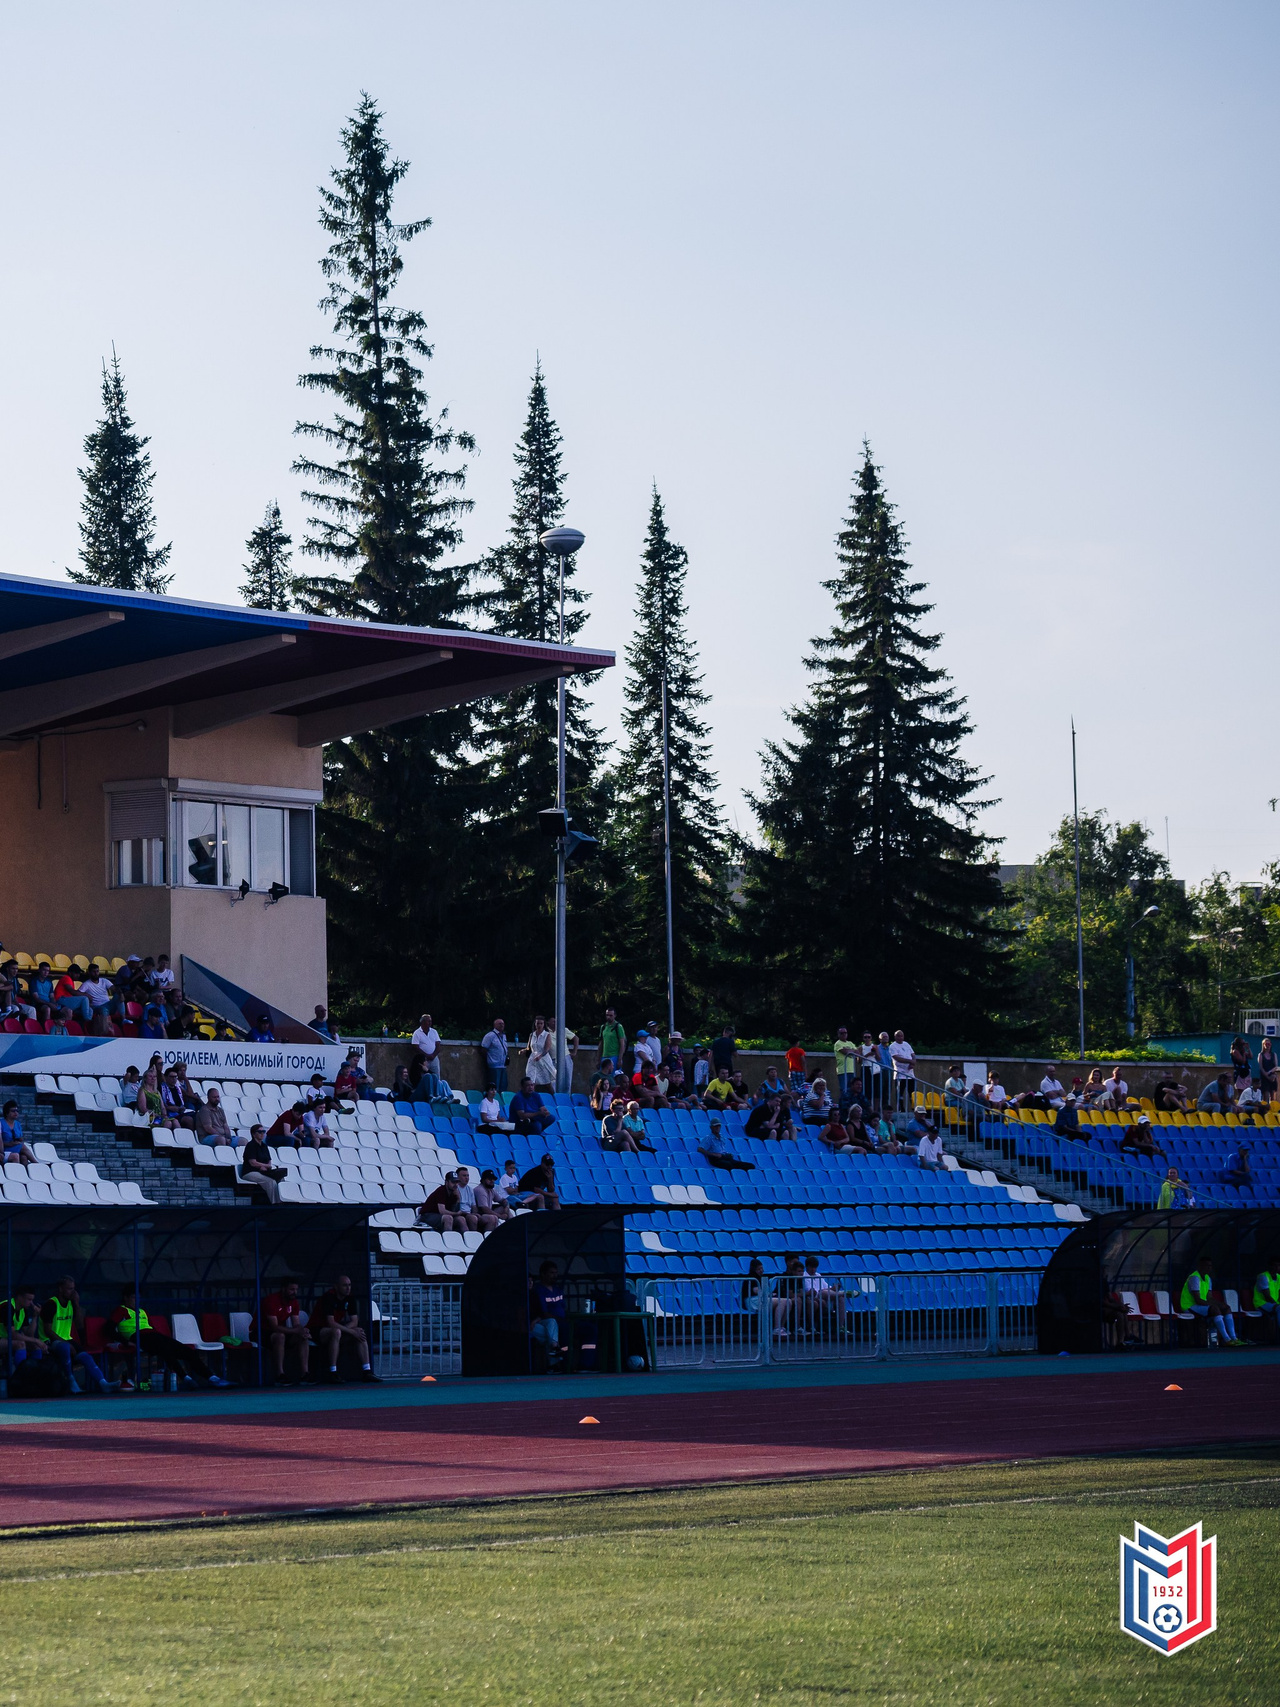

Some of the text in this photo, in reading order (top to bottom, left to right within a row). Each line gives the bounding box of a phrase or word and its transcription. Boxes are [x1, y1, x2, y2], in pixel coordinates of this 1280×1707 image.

[164, 1050, 326, 1071] ЮБИЛЕЕМ, ЛЮБИМЫЙ ГОРОД!
